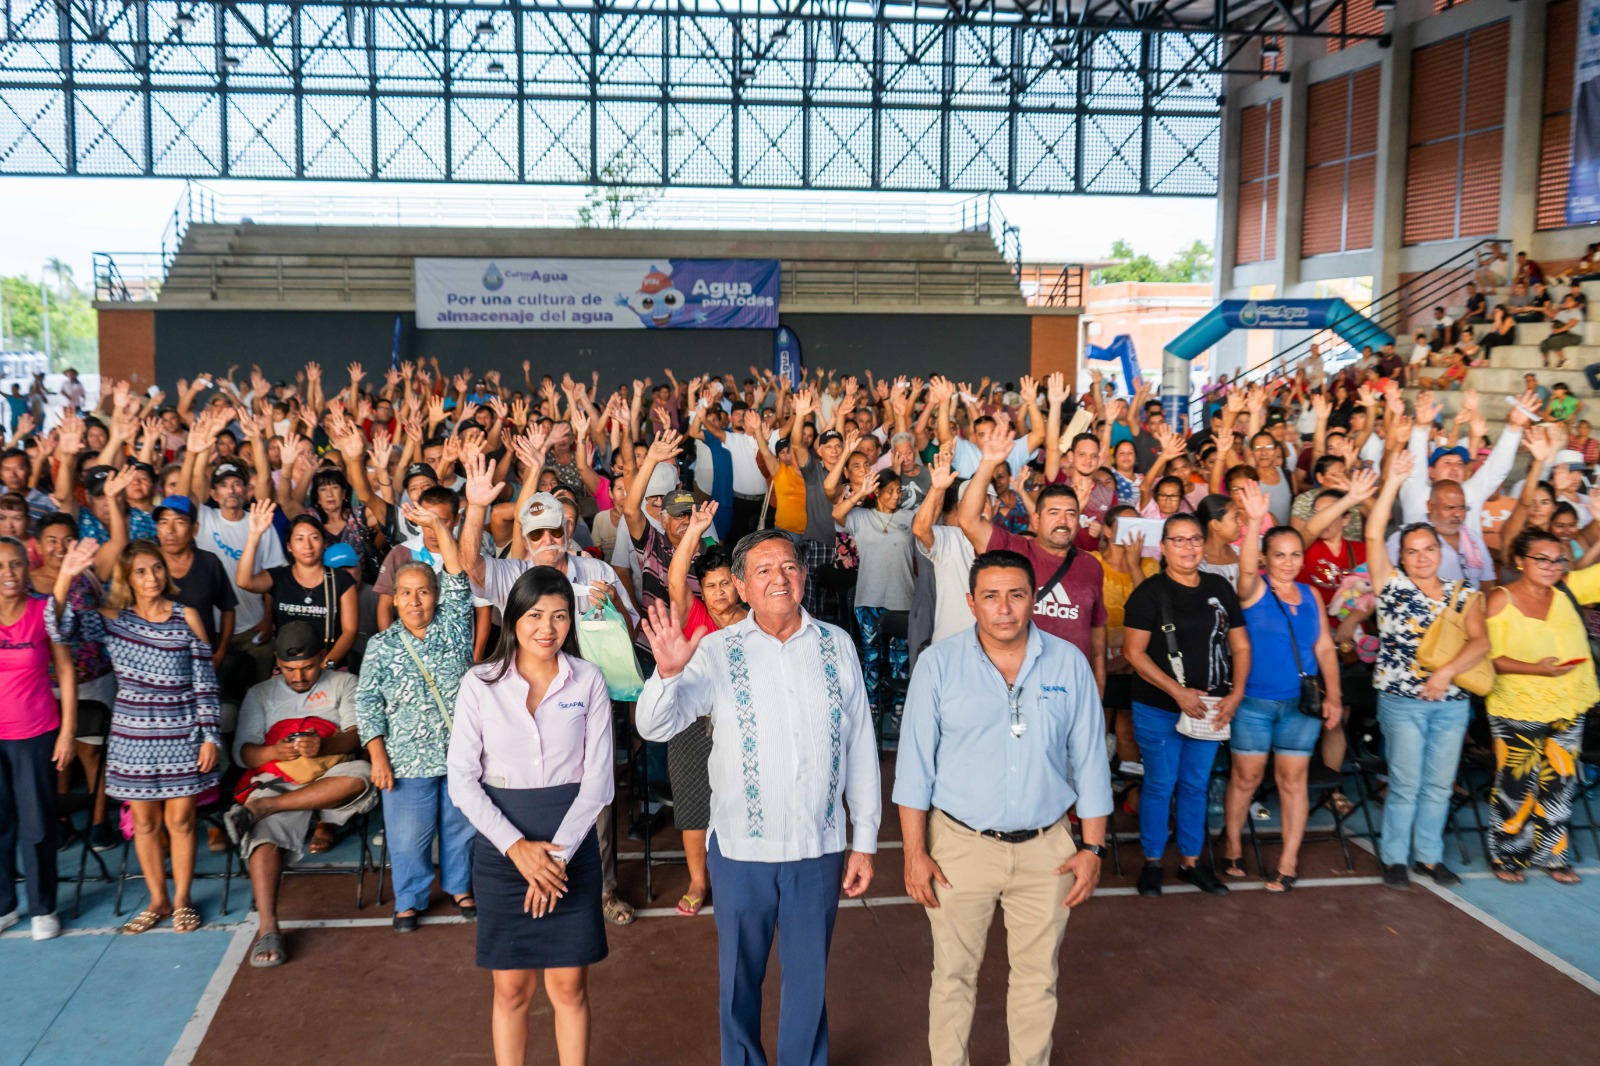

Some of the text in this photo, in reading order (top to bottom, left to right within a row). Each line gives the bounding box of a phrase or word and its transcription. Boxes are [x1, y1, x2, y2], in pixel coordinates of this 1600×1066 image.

[531, 270, 568, 283] Agua
[692, 279, 752, 297] Agua
[447, 293, 602, 305] Por una cultura de
[437, 311, 613, 324] almacenaje del agua
[1033, 600, 1079, 619] didas
